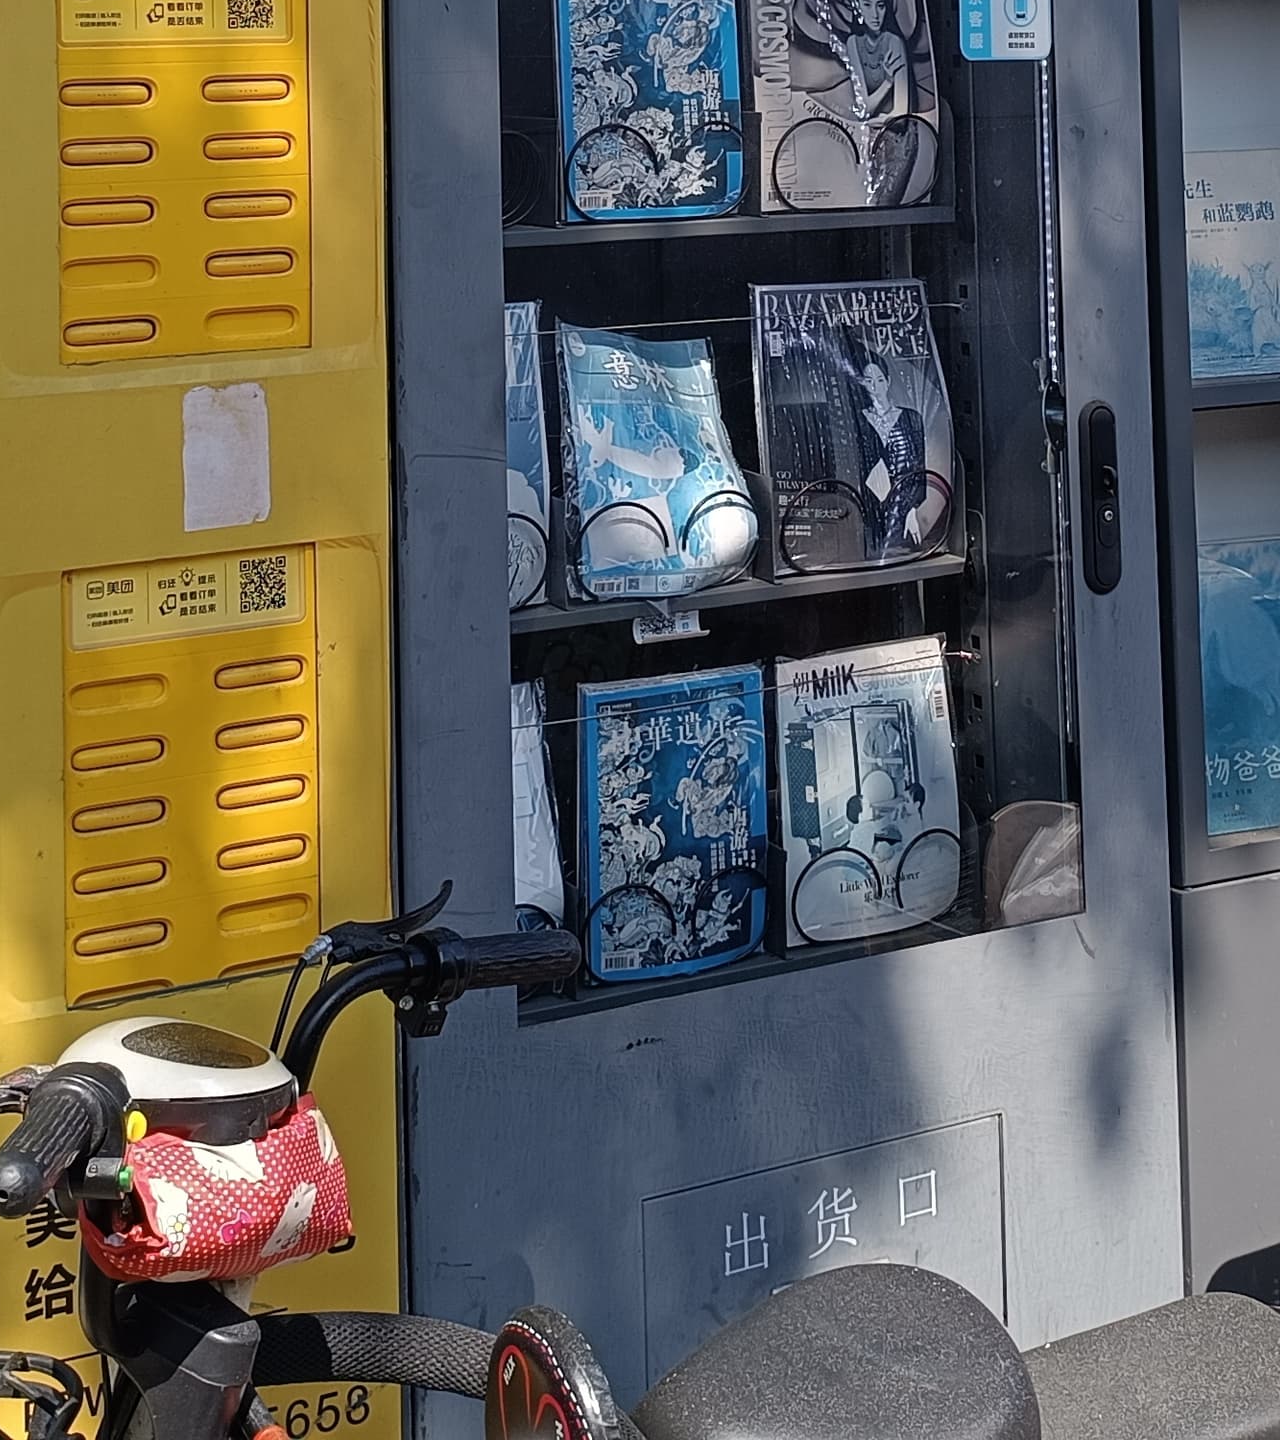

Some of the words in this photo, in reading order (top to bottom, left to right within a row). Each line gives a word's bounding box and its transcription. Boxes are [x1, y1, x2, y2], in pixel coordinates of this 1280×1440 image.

[1201, 201, 1275, 225] 和蓝鹦鹉
[603, 350, 675, 394] 意林
[107, 579, 134, 596] 美团
[725, 1169, 937, 1277] 出货口
[24, 1263, 77, 1321] 给
